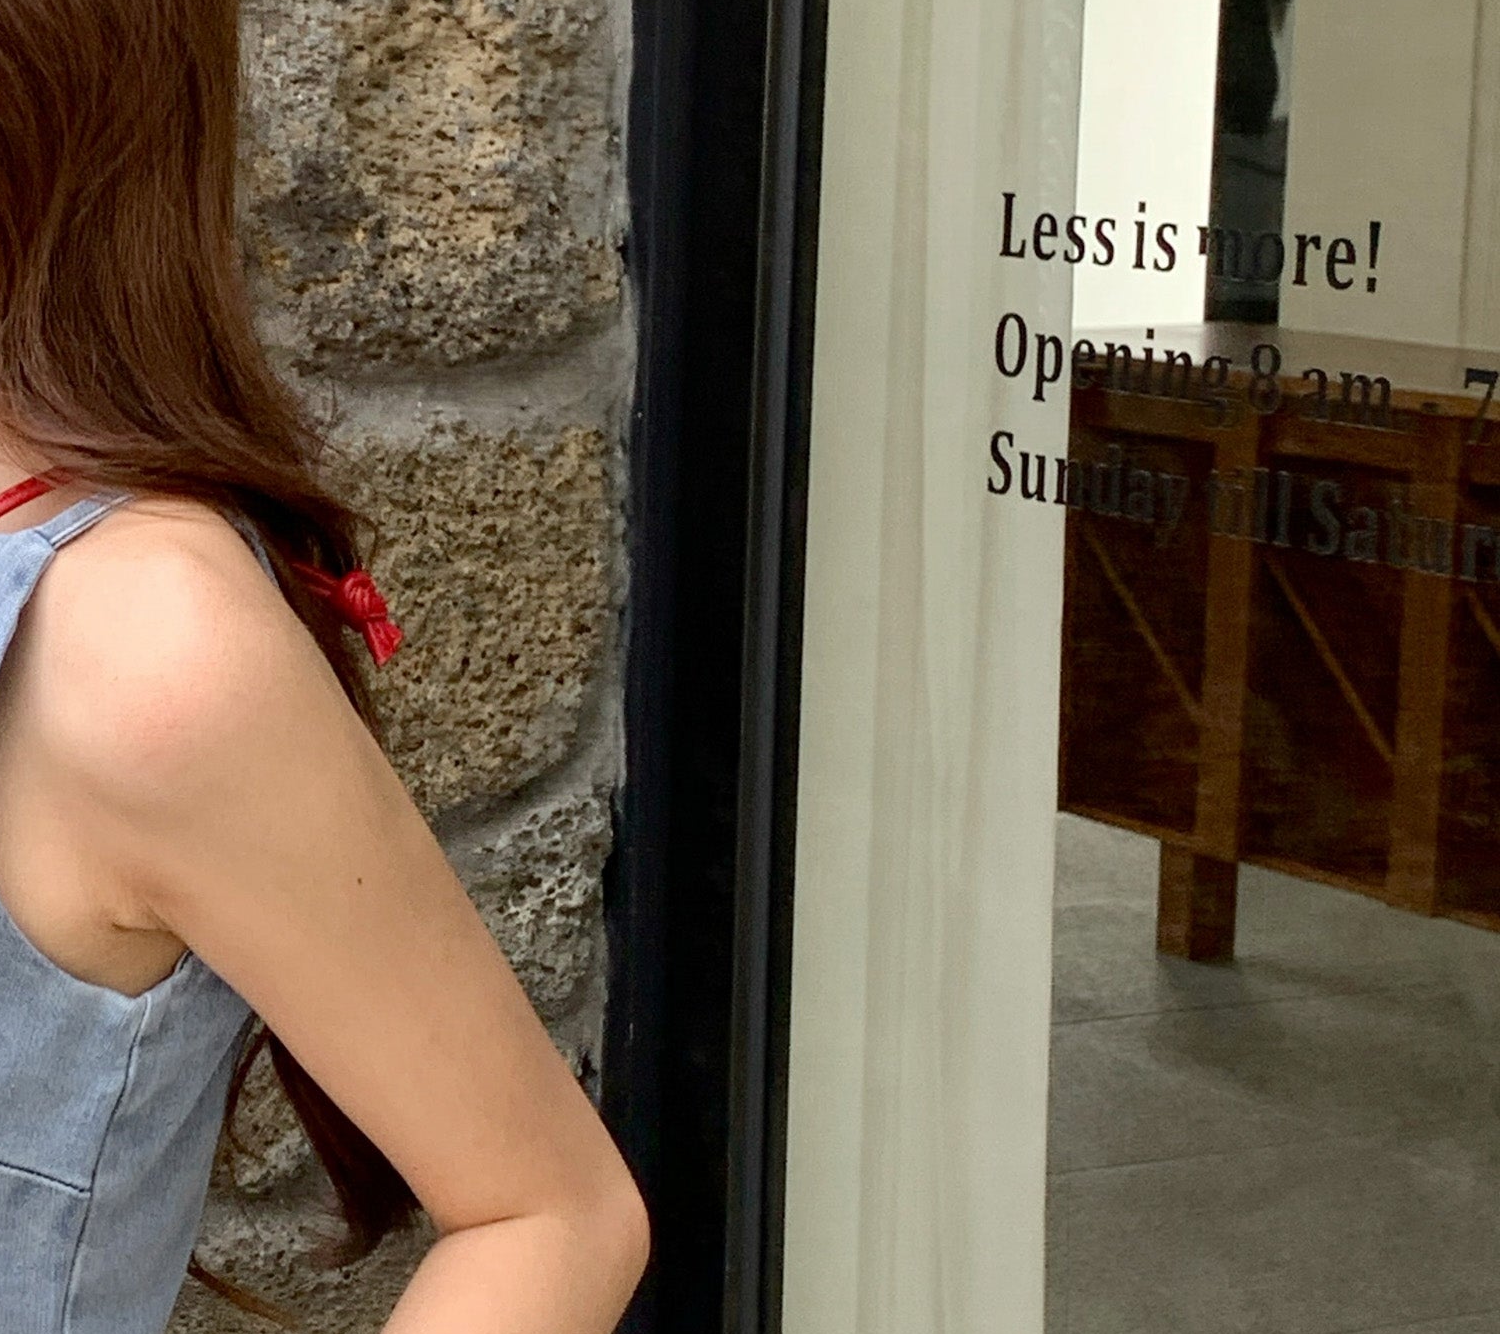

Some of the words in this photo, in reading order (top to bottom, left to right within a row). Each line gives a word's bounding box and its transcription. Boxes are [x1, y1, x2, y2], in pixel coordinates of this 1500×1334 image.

[1000, 192, 1116, 267] Less
[1132, 201, 1179, 272] is
[1196, 221, 1382, 293] more!
[995, 313, 1233, 427] Opening
[1249, 343, 1283, 414] 8
[1300, 368, 1393, 430] am
[1464, 368, 1499, 446] 7
[987, 430, 1190, 549] Sunday
[1306, 479, 1500, 583] Satur
